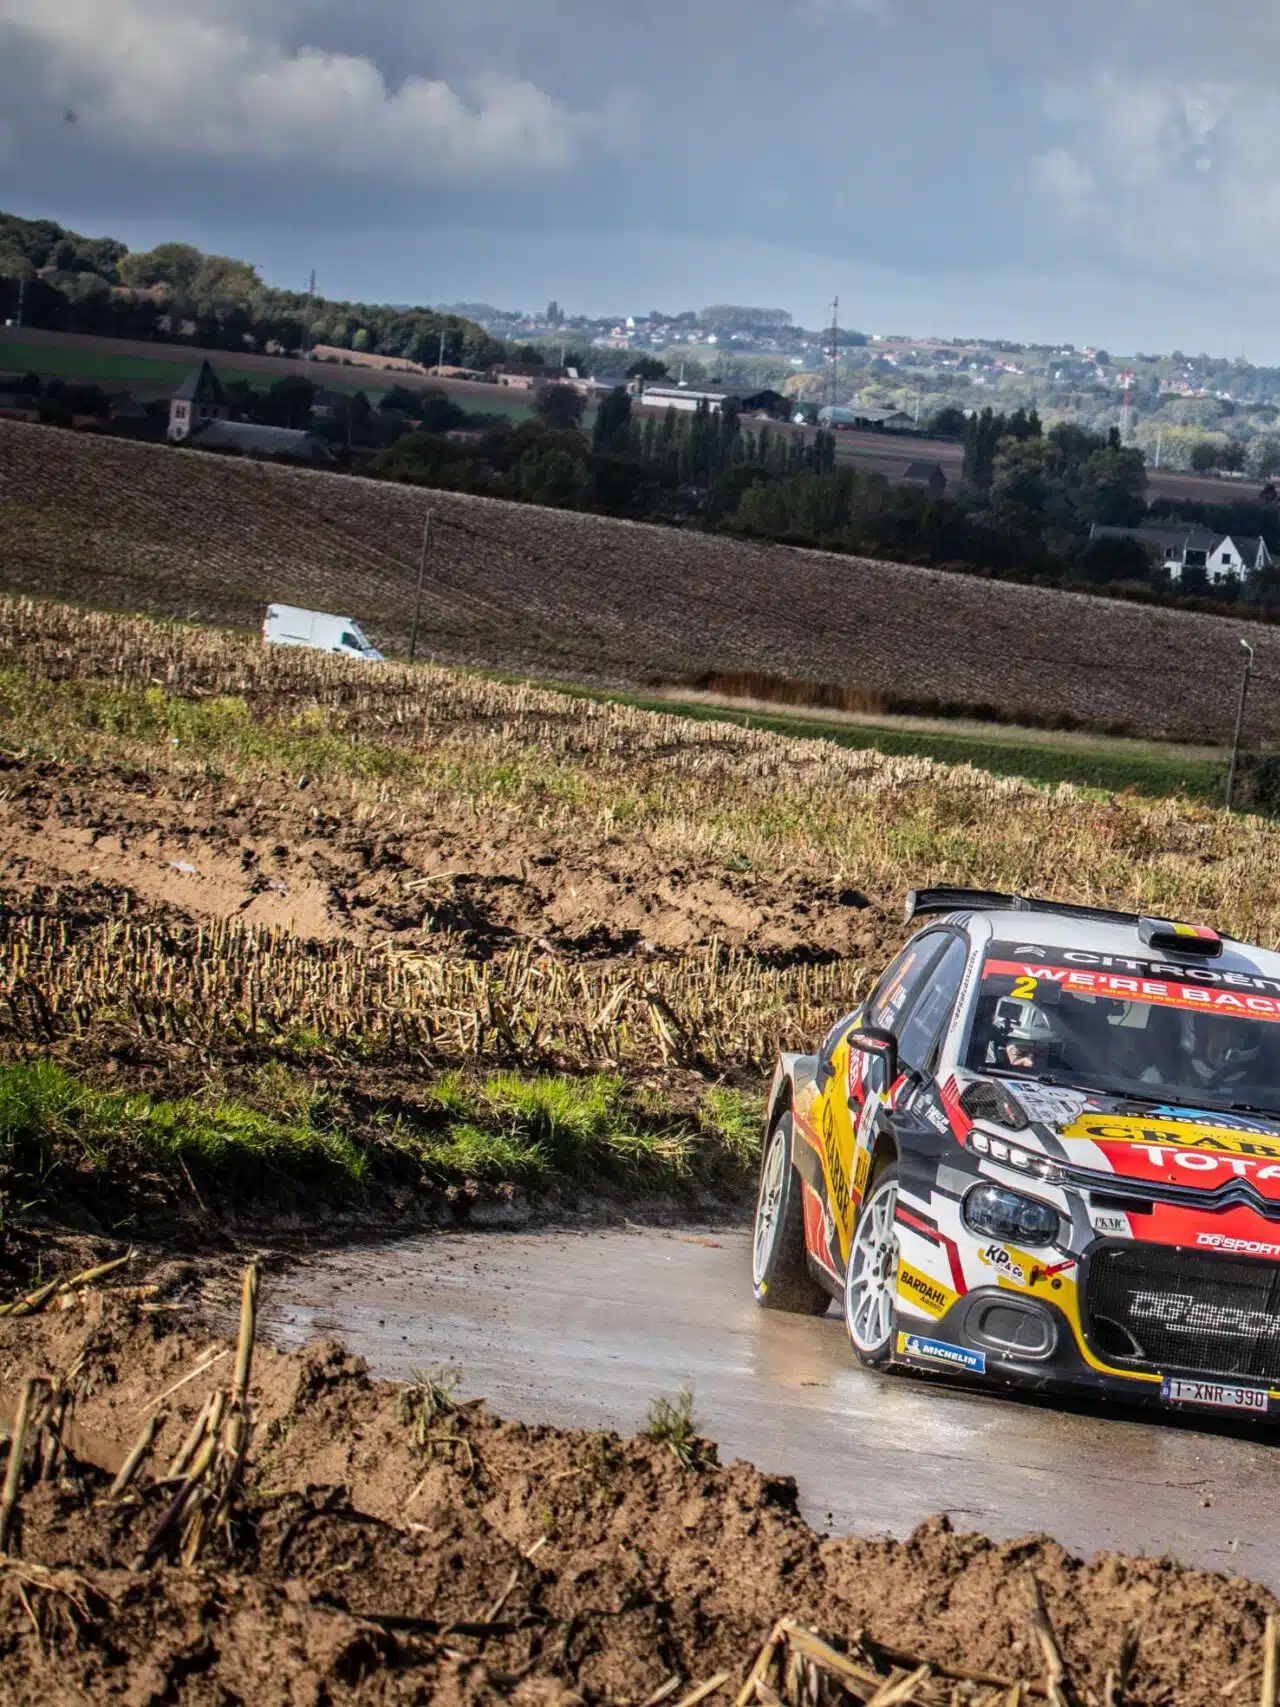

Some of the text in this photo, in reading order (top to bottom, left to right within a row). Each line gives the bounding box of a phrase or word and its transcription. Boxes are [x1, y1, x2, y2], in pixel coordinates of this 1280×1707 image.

[1010, 976, 1039, 1000] 2
[1023, 966, 1168, 996] WE'RE
[1102, 988, 1222, 1009] MOTORSPORT
[986, 1244, 1009, 1264] KP
[900, 1271, 946, 1306] BARDAHL
[922, 1345, 977, 1365] MICHELIN
[1175, 1381, 1264, 1408] 1-XNR-990
